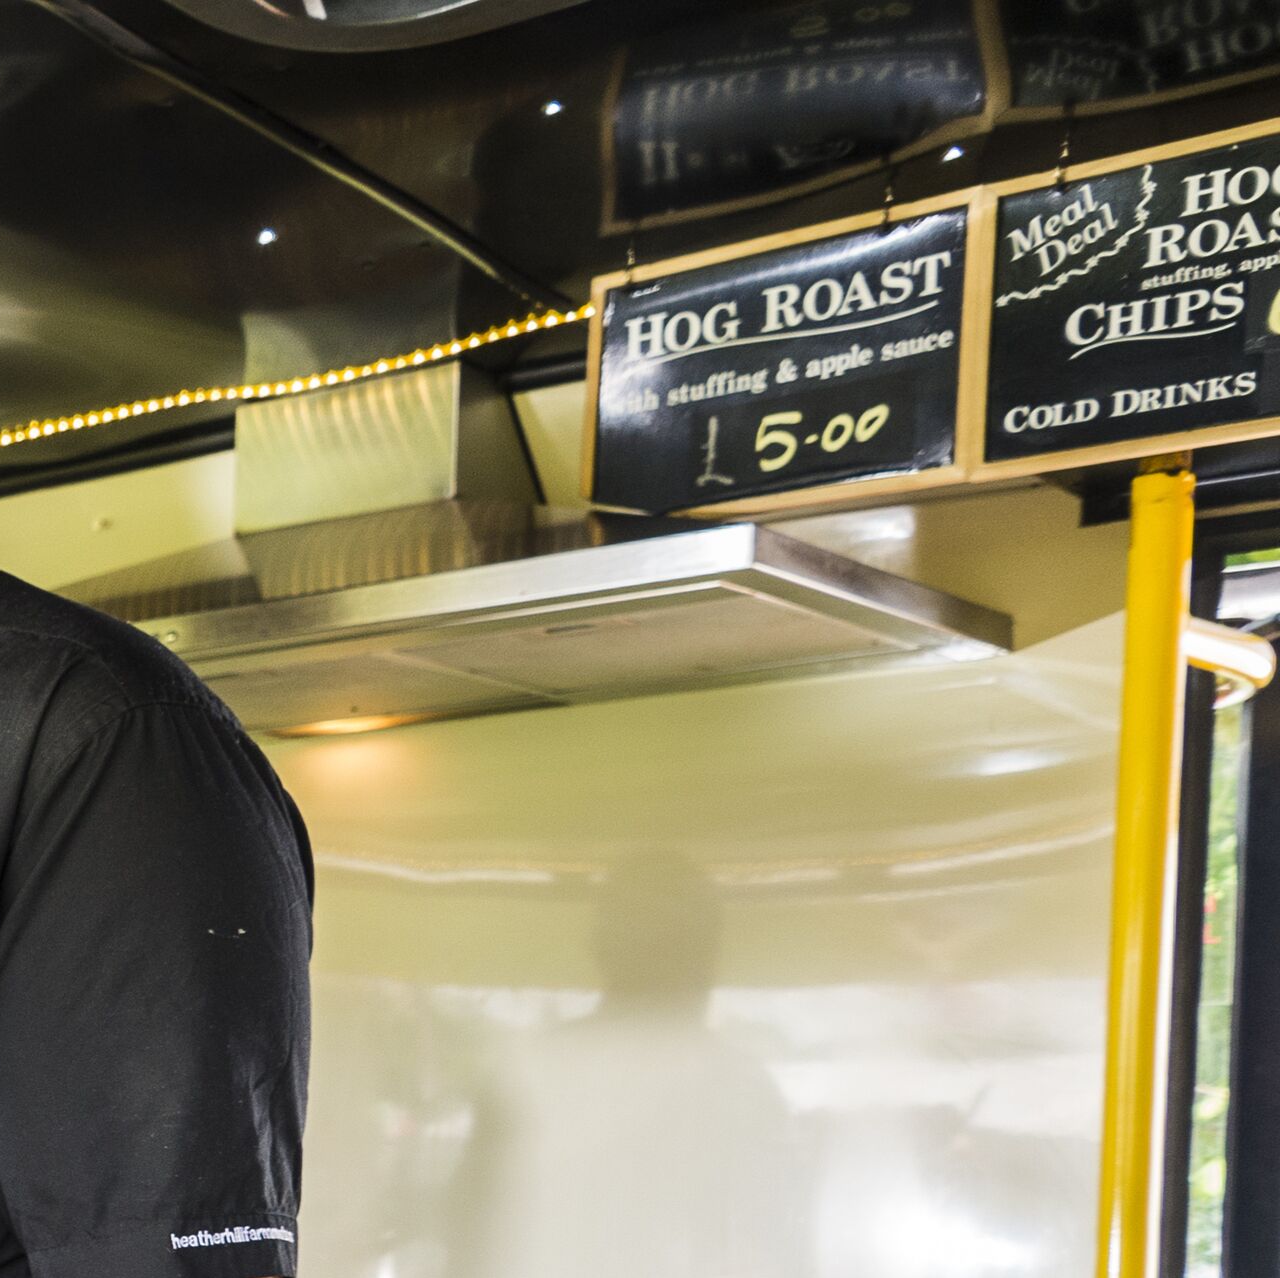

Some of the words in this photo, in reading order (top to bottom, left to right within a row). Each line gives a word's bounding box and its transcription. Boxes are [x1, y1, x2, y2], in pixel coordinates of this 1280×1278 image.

[1005, 184, 1099, 262] Meal
[1179, 165, 1280, 218] HO
[1034, 202, 1120, 277] Deal
[1140, 263, 1233, 291] stuffing,
[1238, 250, 1280, 274] app
[624, 300, 741, 361] HOG
[760, 252, 952, 333] ROAST
[1064, 281, 1245, 346] CHIPS
[667, 367, 768, 408] stuffing
[775, 358, 798, 384] &
[805, 344, 874, 381] apple
[880, 327, 955, 363] sauce
[1003, 398, 1100, 434] COLD
[1109, 371, 1258, 418] DRINKS
